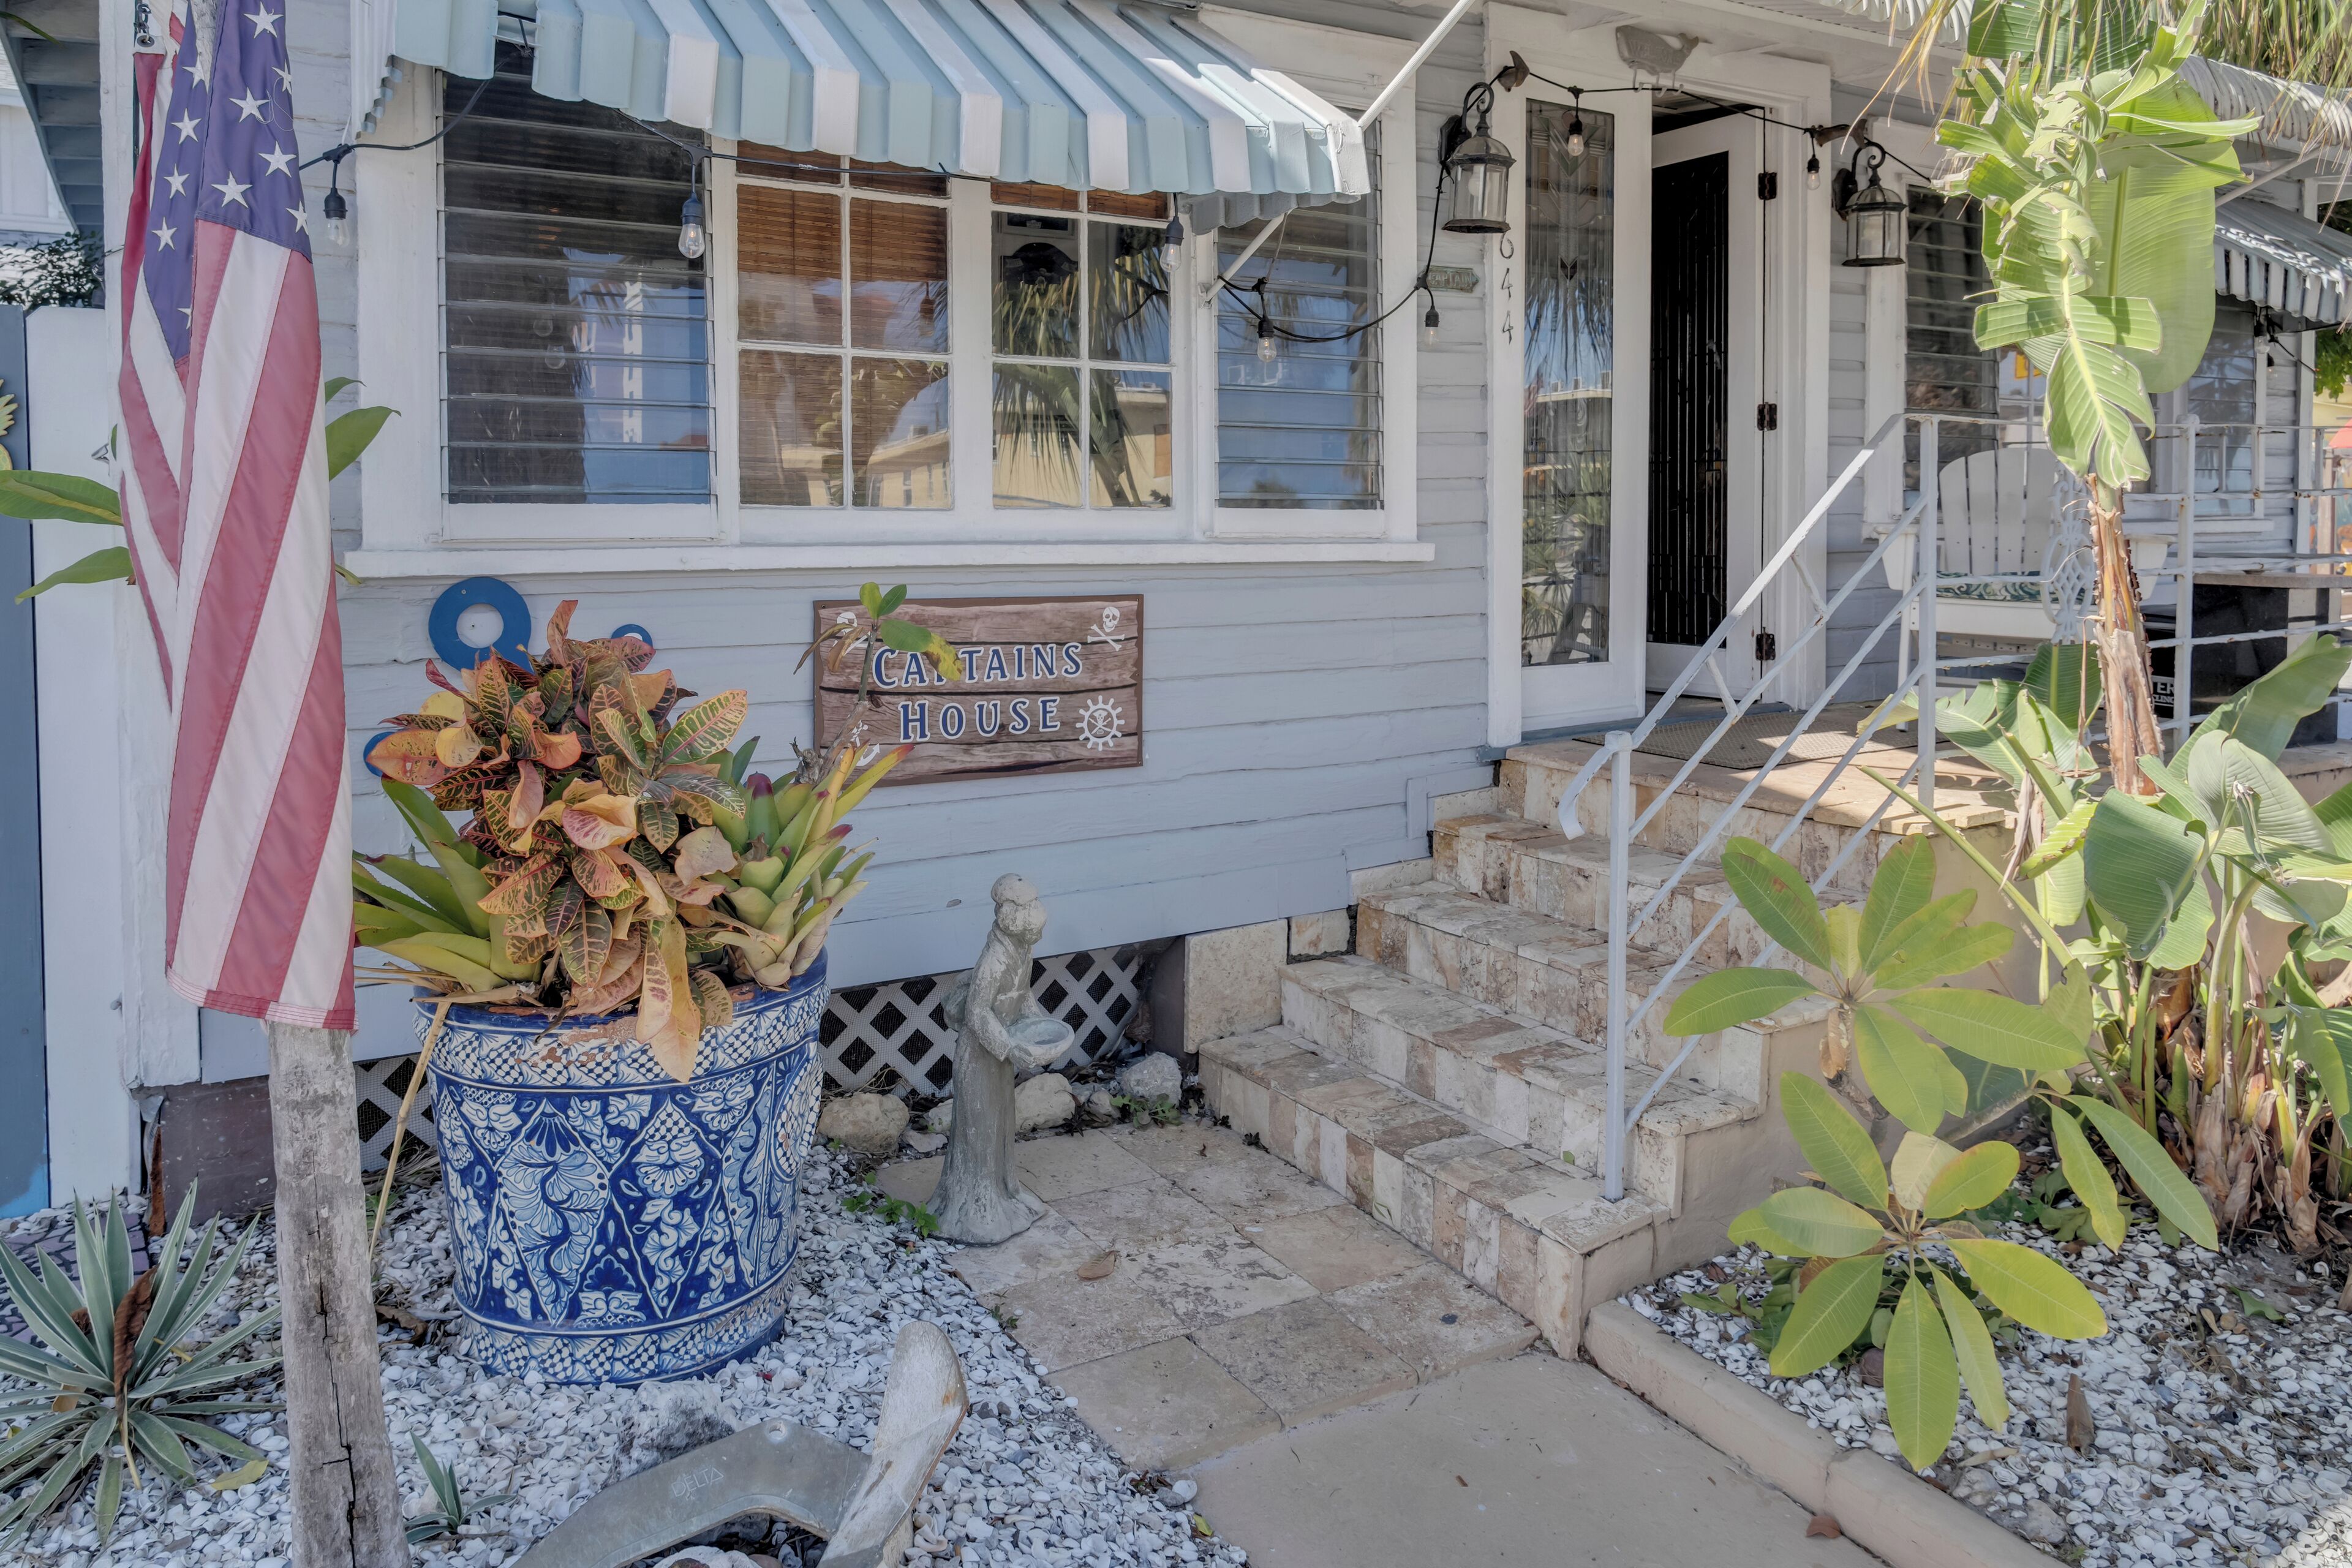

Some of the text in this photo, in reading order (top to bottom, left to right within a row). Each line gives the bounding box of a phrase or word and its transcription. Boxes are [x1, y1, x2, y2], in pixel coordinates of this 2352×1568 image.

[872, 643, 1083, 689] CATAINS
[898, 696, 1061, 743] HOUSE
[671, 1467, 724, 1497] DELTA
